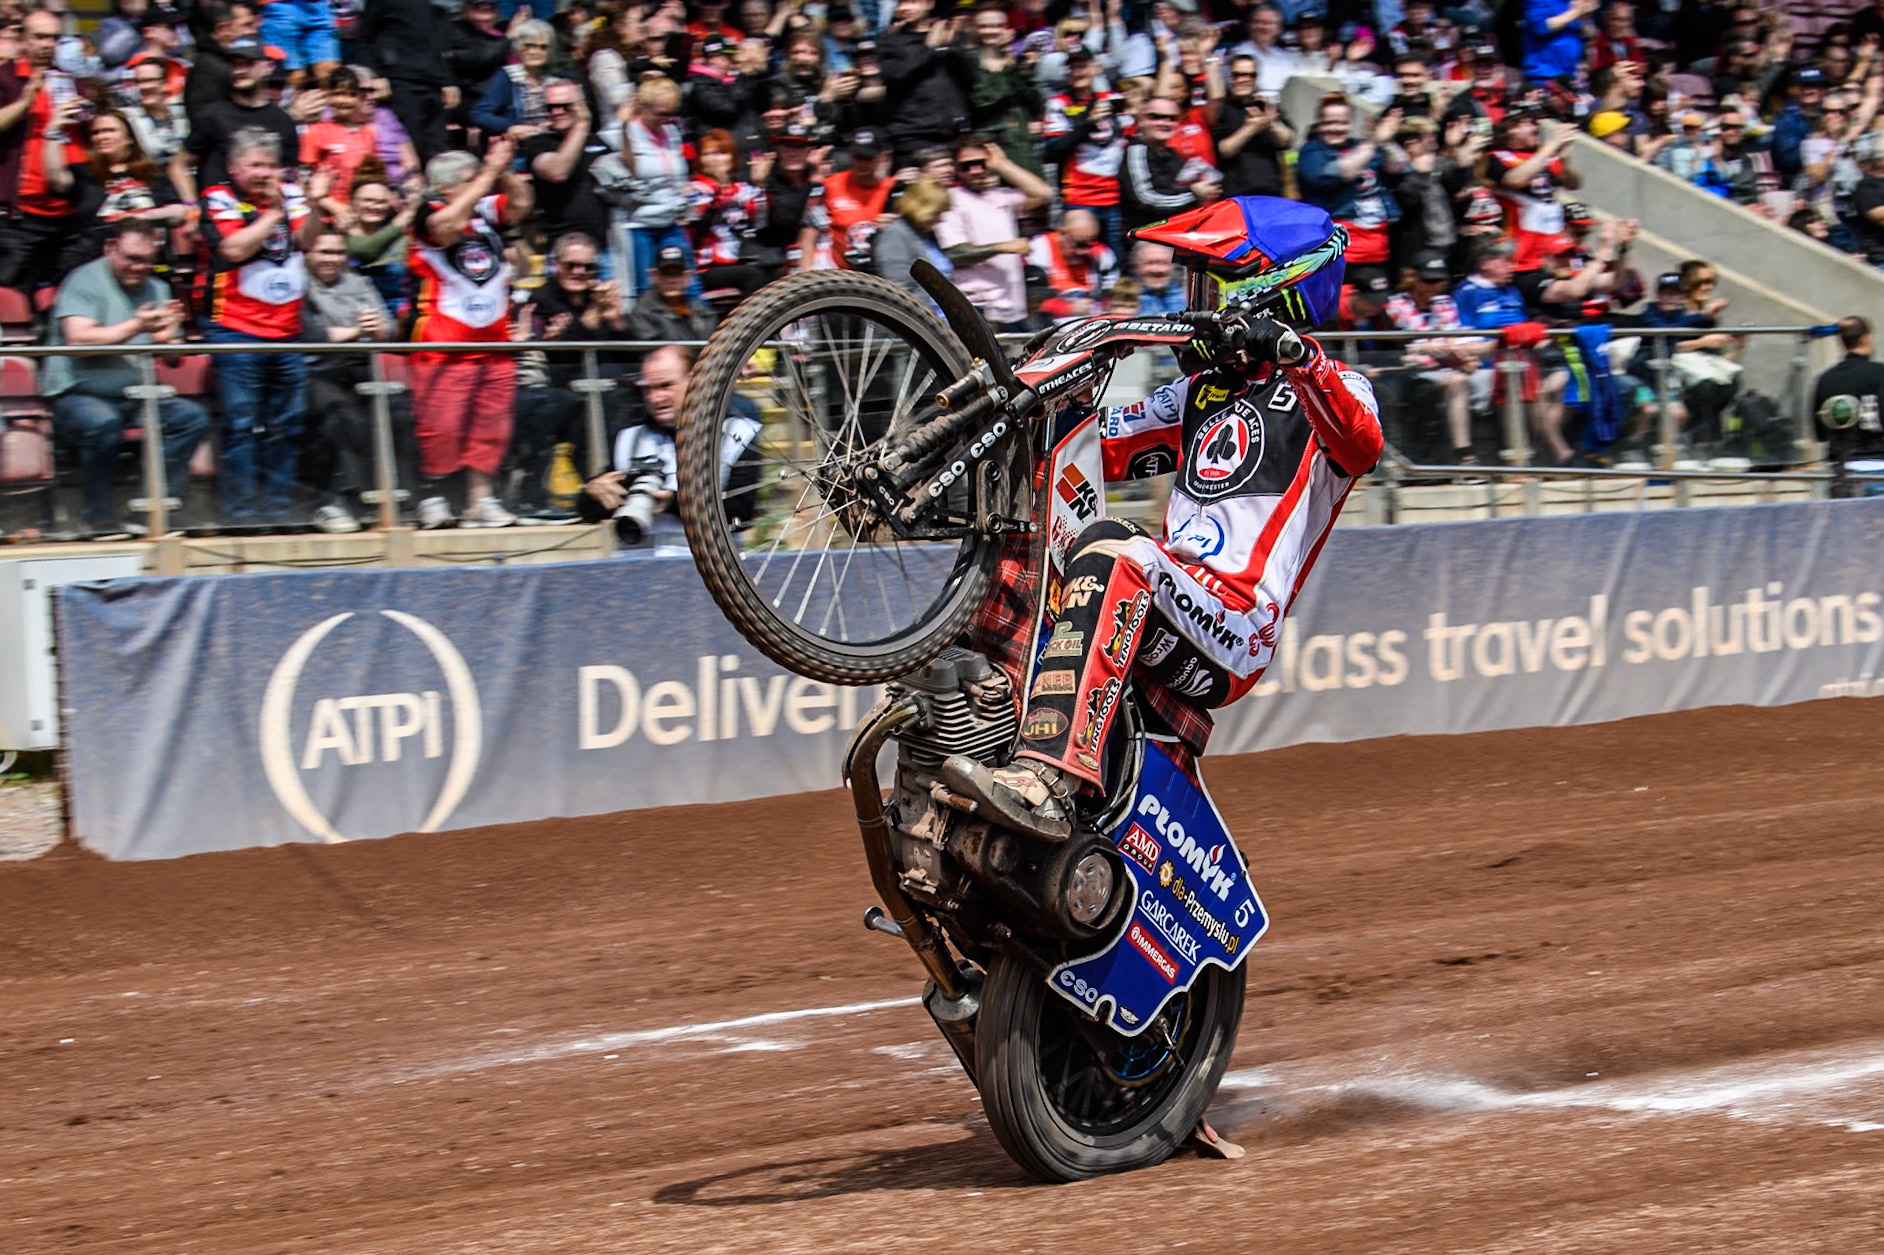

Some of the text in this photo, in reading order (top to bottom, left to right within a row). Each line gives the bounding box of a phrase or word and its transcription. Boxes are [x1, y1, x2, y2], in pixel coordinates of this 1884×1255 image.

[1268, 383, 1298, 412] 5
[970, 422, 1007, 459] CSO
[1197, 410, 1229, 441] BELLE
[1247, 417, 1261, 444] ACES
[928, 460, 967, 497] CSO
[1065, 591, 1093, 609] N
[1249, 615, 1409, 697] lass
[1423, 593, 1607, 682] travel
[1621, 580, 1884, 664] solutions
[301, 690, 443, 769] ATPI
[1122, 843, 1154, 869] GROUP
[1126, 828, 1160, 862] AMD
[1140, 889, 1202, 963] GARCAREK
[1234, 898, 1256, 929] 5
[1136, 933, 1177, 979] IMMERGAS
[1059, 969, 1099, 1003] CSO
